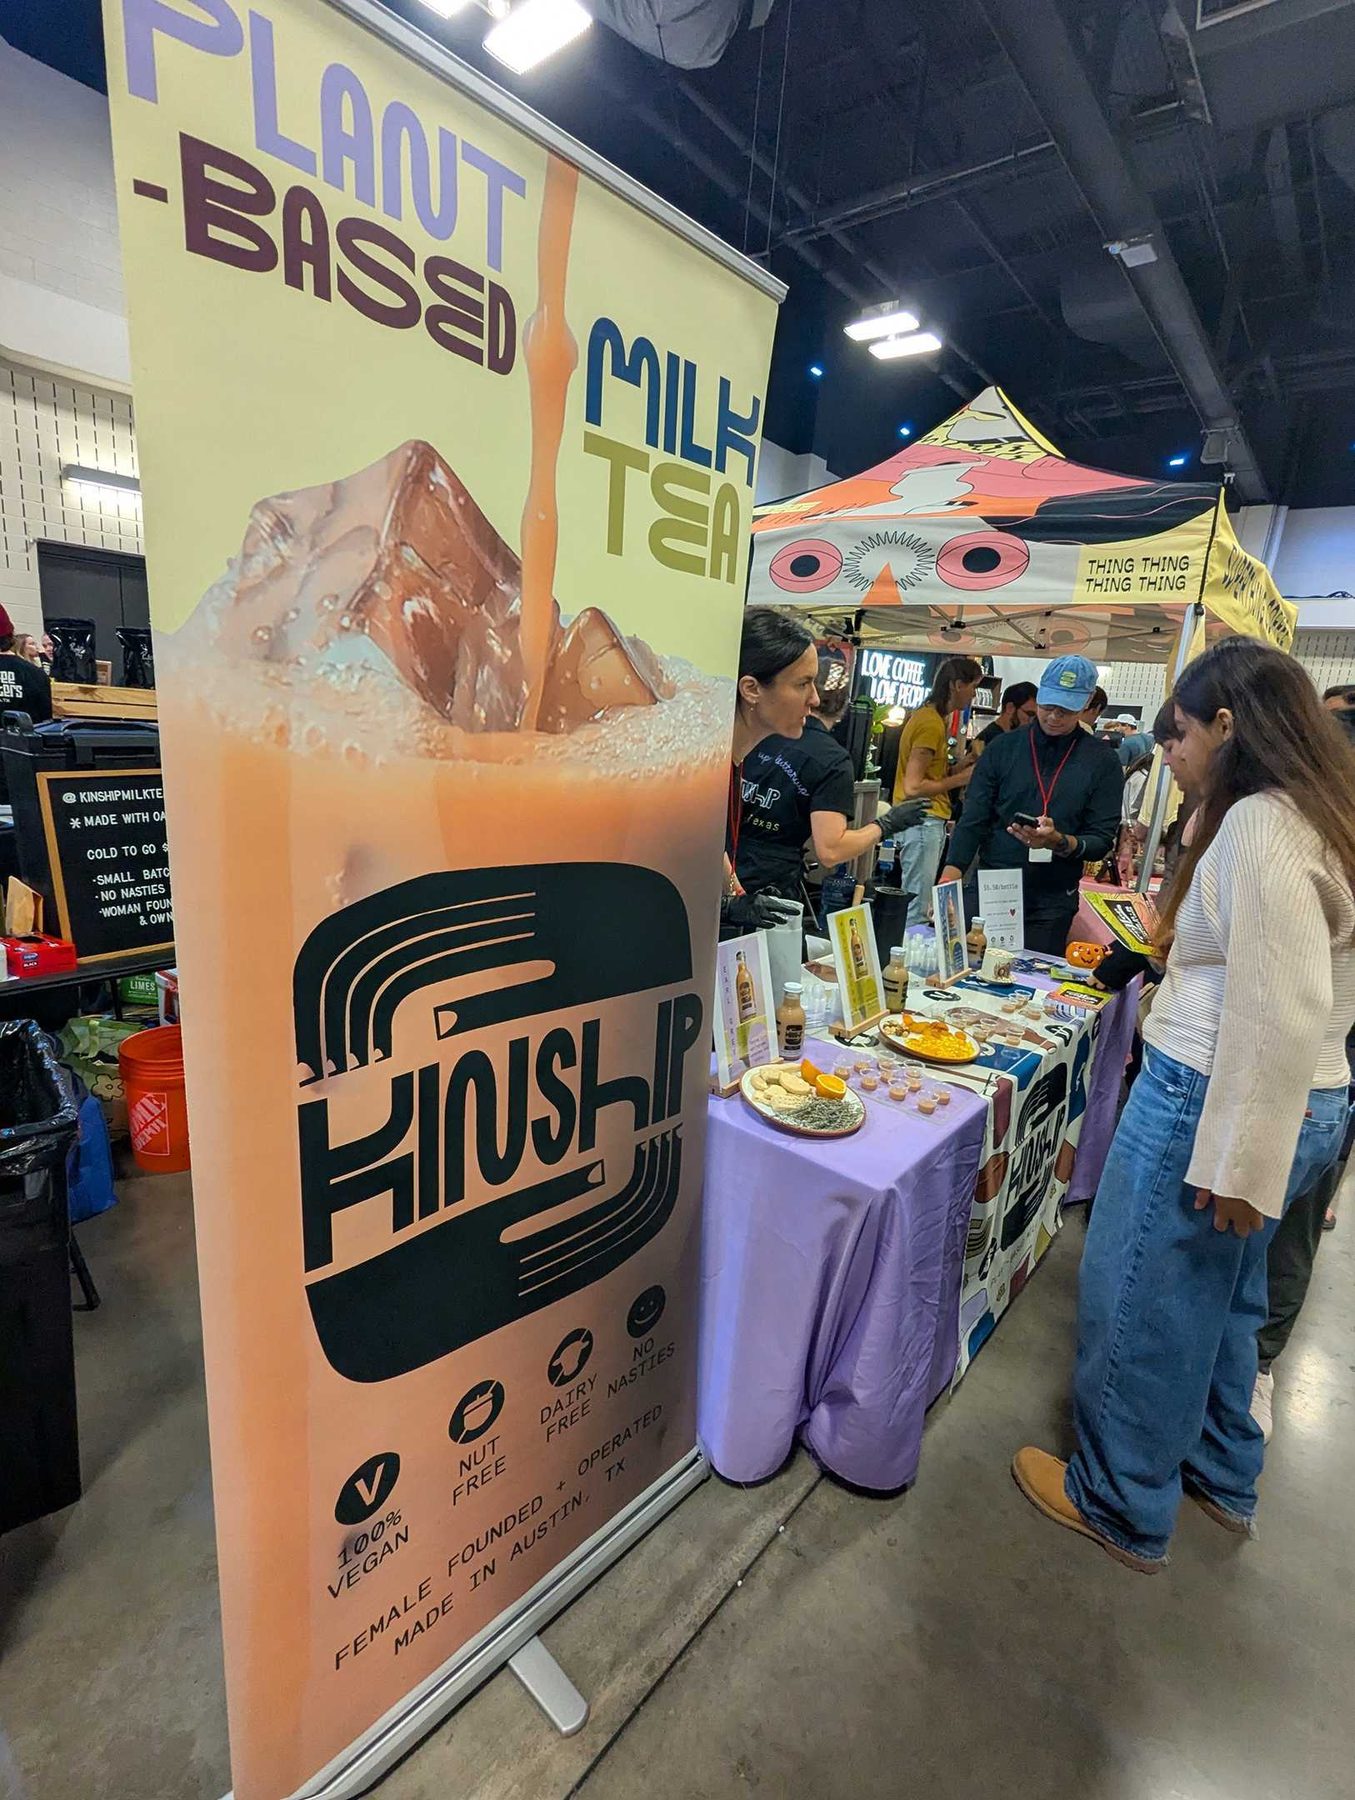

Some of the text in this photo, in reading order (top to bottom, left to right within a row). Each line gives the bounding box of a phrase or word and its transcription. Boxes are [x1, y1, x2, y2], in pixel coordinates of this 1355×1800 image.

[121, 0, 526, 272] PLANT
[586, 317, 761, 488] MILK
[583, 430, 740, 585] TEA
[1086, 575, 1187, 593] THING THING
[1088, 555, 1190, 574] THING THING
[861, 650, 926, 686] LOVE COFFEE
[870, 677, 899, 706] LOVE
[84, 814, 118, 827] MADE
[122, 812, 149, 825] WITH
[87, 846, 118, 860] COLD
[122, 845, 137, 857] TO
[142, 844, 156, 856] GO
[121, 884, 166, 899] NASTIES
[130, 979, 155, 991] LIMES
[297, 993, 703, 1273] KINSHIP
[607, 1342, 676, 1399] NASTIES
[633, 1337, 654, 1362] NO
[540, 1373, 598, 1425] DAIRY
[546, 1398, 592, 1443] FREE
[452, 1455, 507, 1507] FREE
[458, 1436, 502, 1478] NUT
[335, 1576, 432, 1671] FEMALE
[448, 1494, 544, 1578] FOUNDED
[577, 1404, 663, 1477] OPERATED
[338, 1509, 402, 1570] 100%
[394, 1592, 454, 1656] MADE
[469, 1557, 496, 1592] IN
[604, 1458, 626, 1482] TX
[327, 1525, 409, 1599] VEGAN
